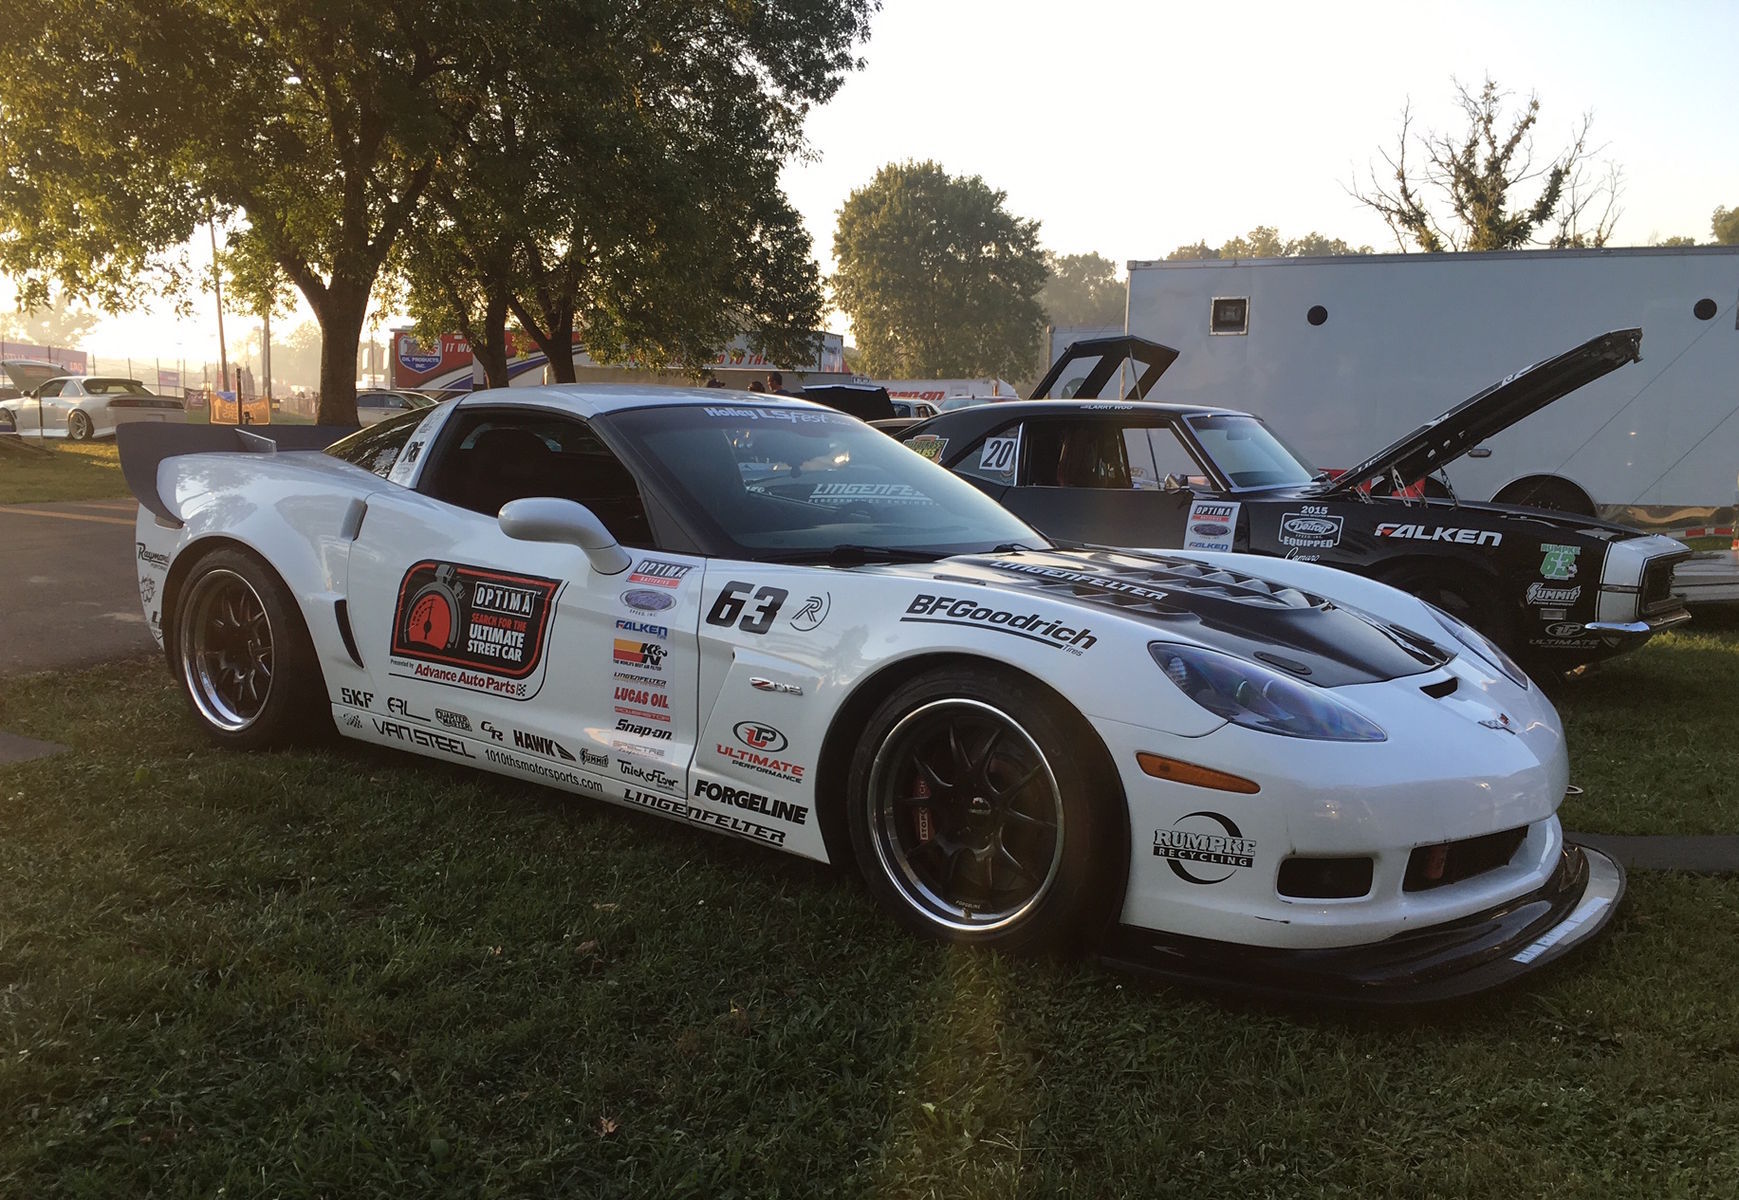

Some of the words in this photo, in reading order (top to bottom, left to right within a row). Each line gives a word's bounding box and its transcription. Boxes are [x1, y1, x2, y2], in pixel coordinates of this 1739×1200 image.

[703, 407, 758, 420] Holley
[981, 440, 1014, 468] 20
[1195, 506, 1232, 517] OPTIMA
[1301, 505, 1328, 515] 2015
[1189, 542, 1229, 550] FALKEN
[1283, 536, 1334, 548] EQUIPPED
[1374, 522, 1503, 547] FALKEN
[637, 560, 689, 578] OPTIMA
[989, 560, 1169, 601] LINGENFELTER
[474, 586, 531, 614] OPTIMA
[706, 580, 789, 635] 63
[471, 612, 497, 626] SEARCH
[499, 618, 514, 630] FOR
[514, 621, 527, 633] THE
[615, 619, 668, 637] FALKEN
[905, 594, 1098, 650] BFGoodrich
[469, 623, 525, 648] ULTIMATE
[467, 640, 501, 659] STREET
[501, 648, 523, 662] CAR
[1062, 643, 1083, 657] Tires
[414, 663, 458, 682] Advance
[457, 671, 485, 688] Auto
[485, 676, 516, 695] Parts
[341, 687, 374, 709] SKF
[614, 686, 650, 706] LUCAS
[650, 693, 670, 709] OIL
[615, 718, 673, 741] Snap-on
[512, 729, 557, 757] HAWK
[484, 748, 604, 793] 1010thsmotorsports.com
[716, 743, 806, 777] ULTIMATE
[731, 759, 803, 784] PERFORMANCE
[693, 779, 809, 826] FORGELINE
[623, 787, 787, 848] LINGENFELTER
[1153, 828, 1257, 858] RUMPKE
[1158, 847, 1248, 866] RECYCLING
